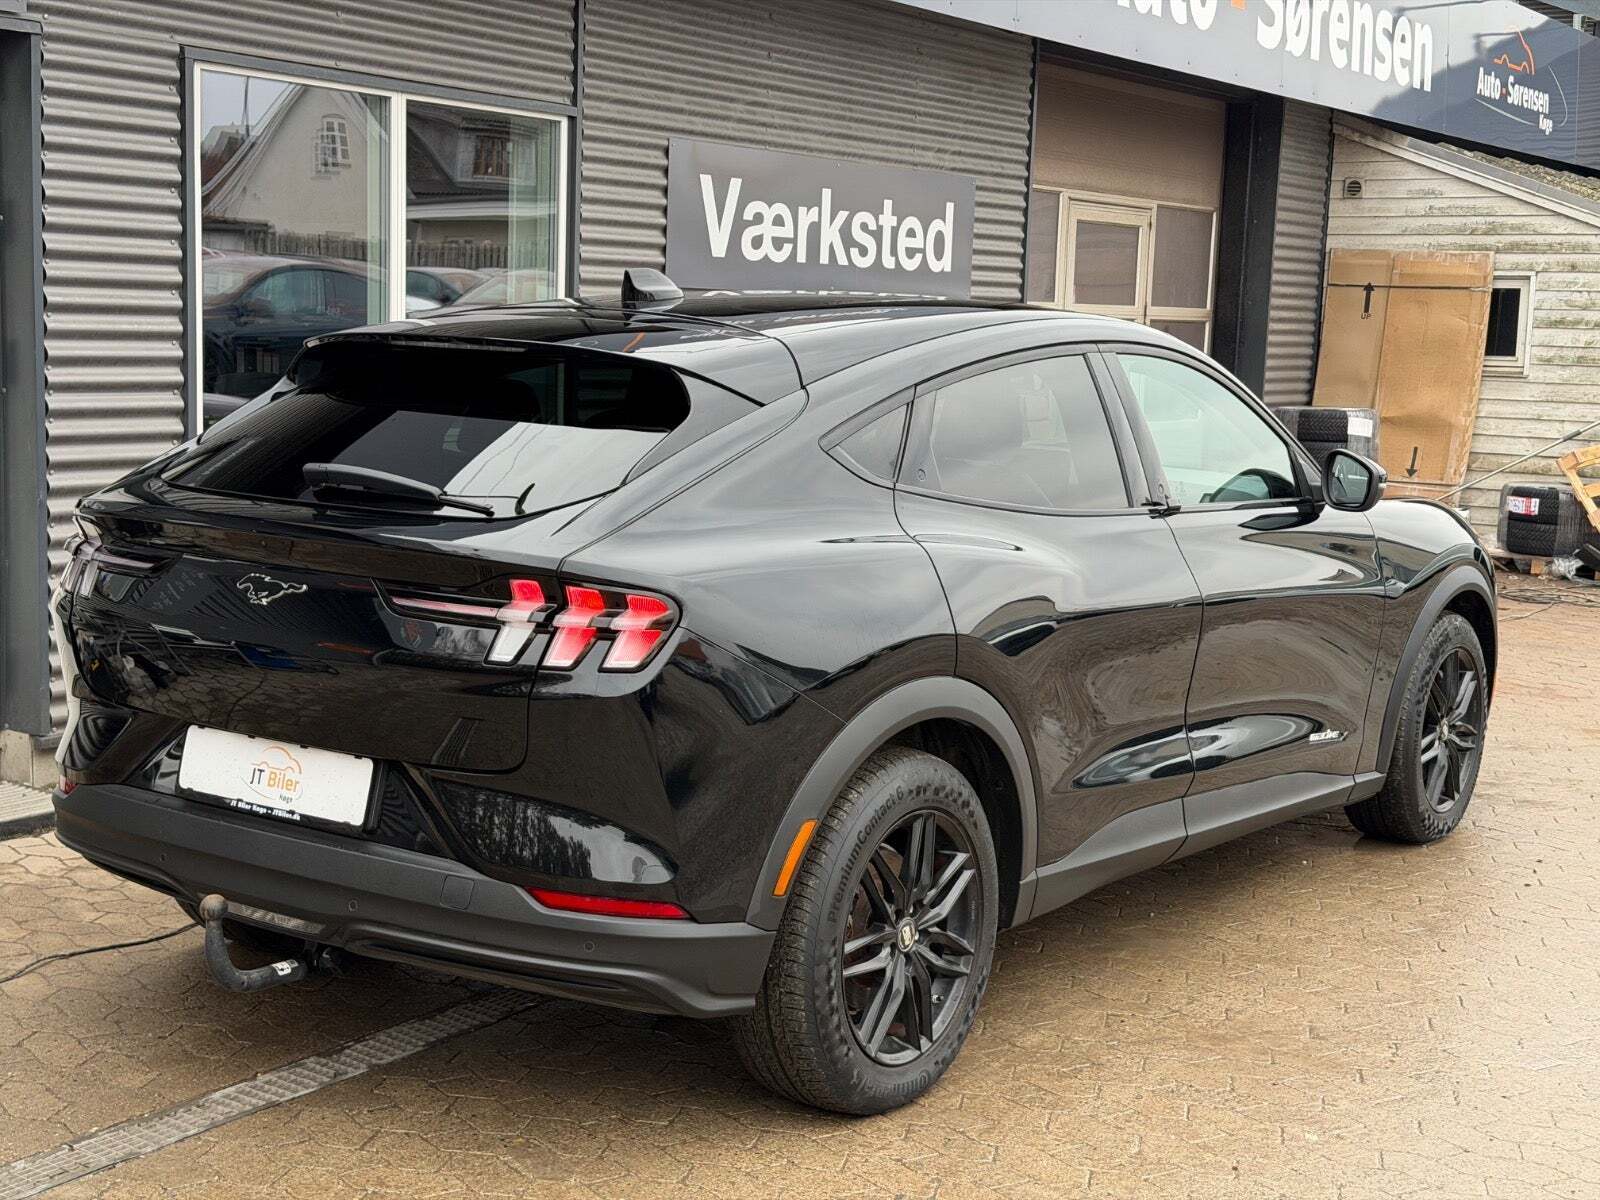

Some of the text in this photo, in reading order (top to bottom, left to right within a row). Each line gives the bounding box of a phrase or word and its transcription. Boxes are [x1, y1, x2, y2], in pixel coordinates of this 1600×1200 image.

[1256, 0, 1433, 92] Sørensen
[1477, 66, 1549, 115] Auto Sørensen
[700, 173, 954, 272] Værksted
[267, 771, 300, 792] Biler
